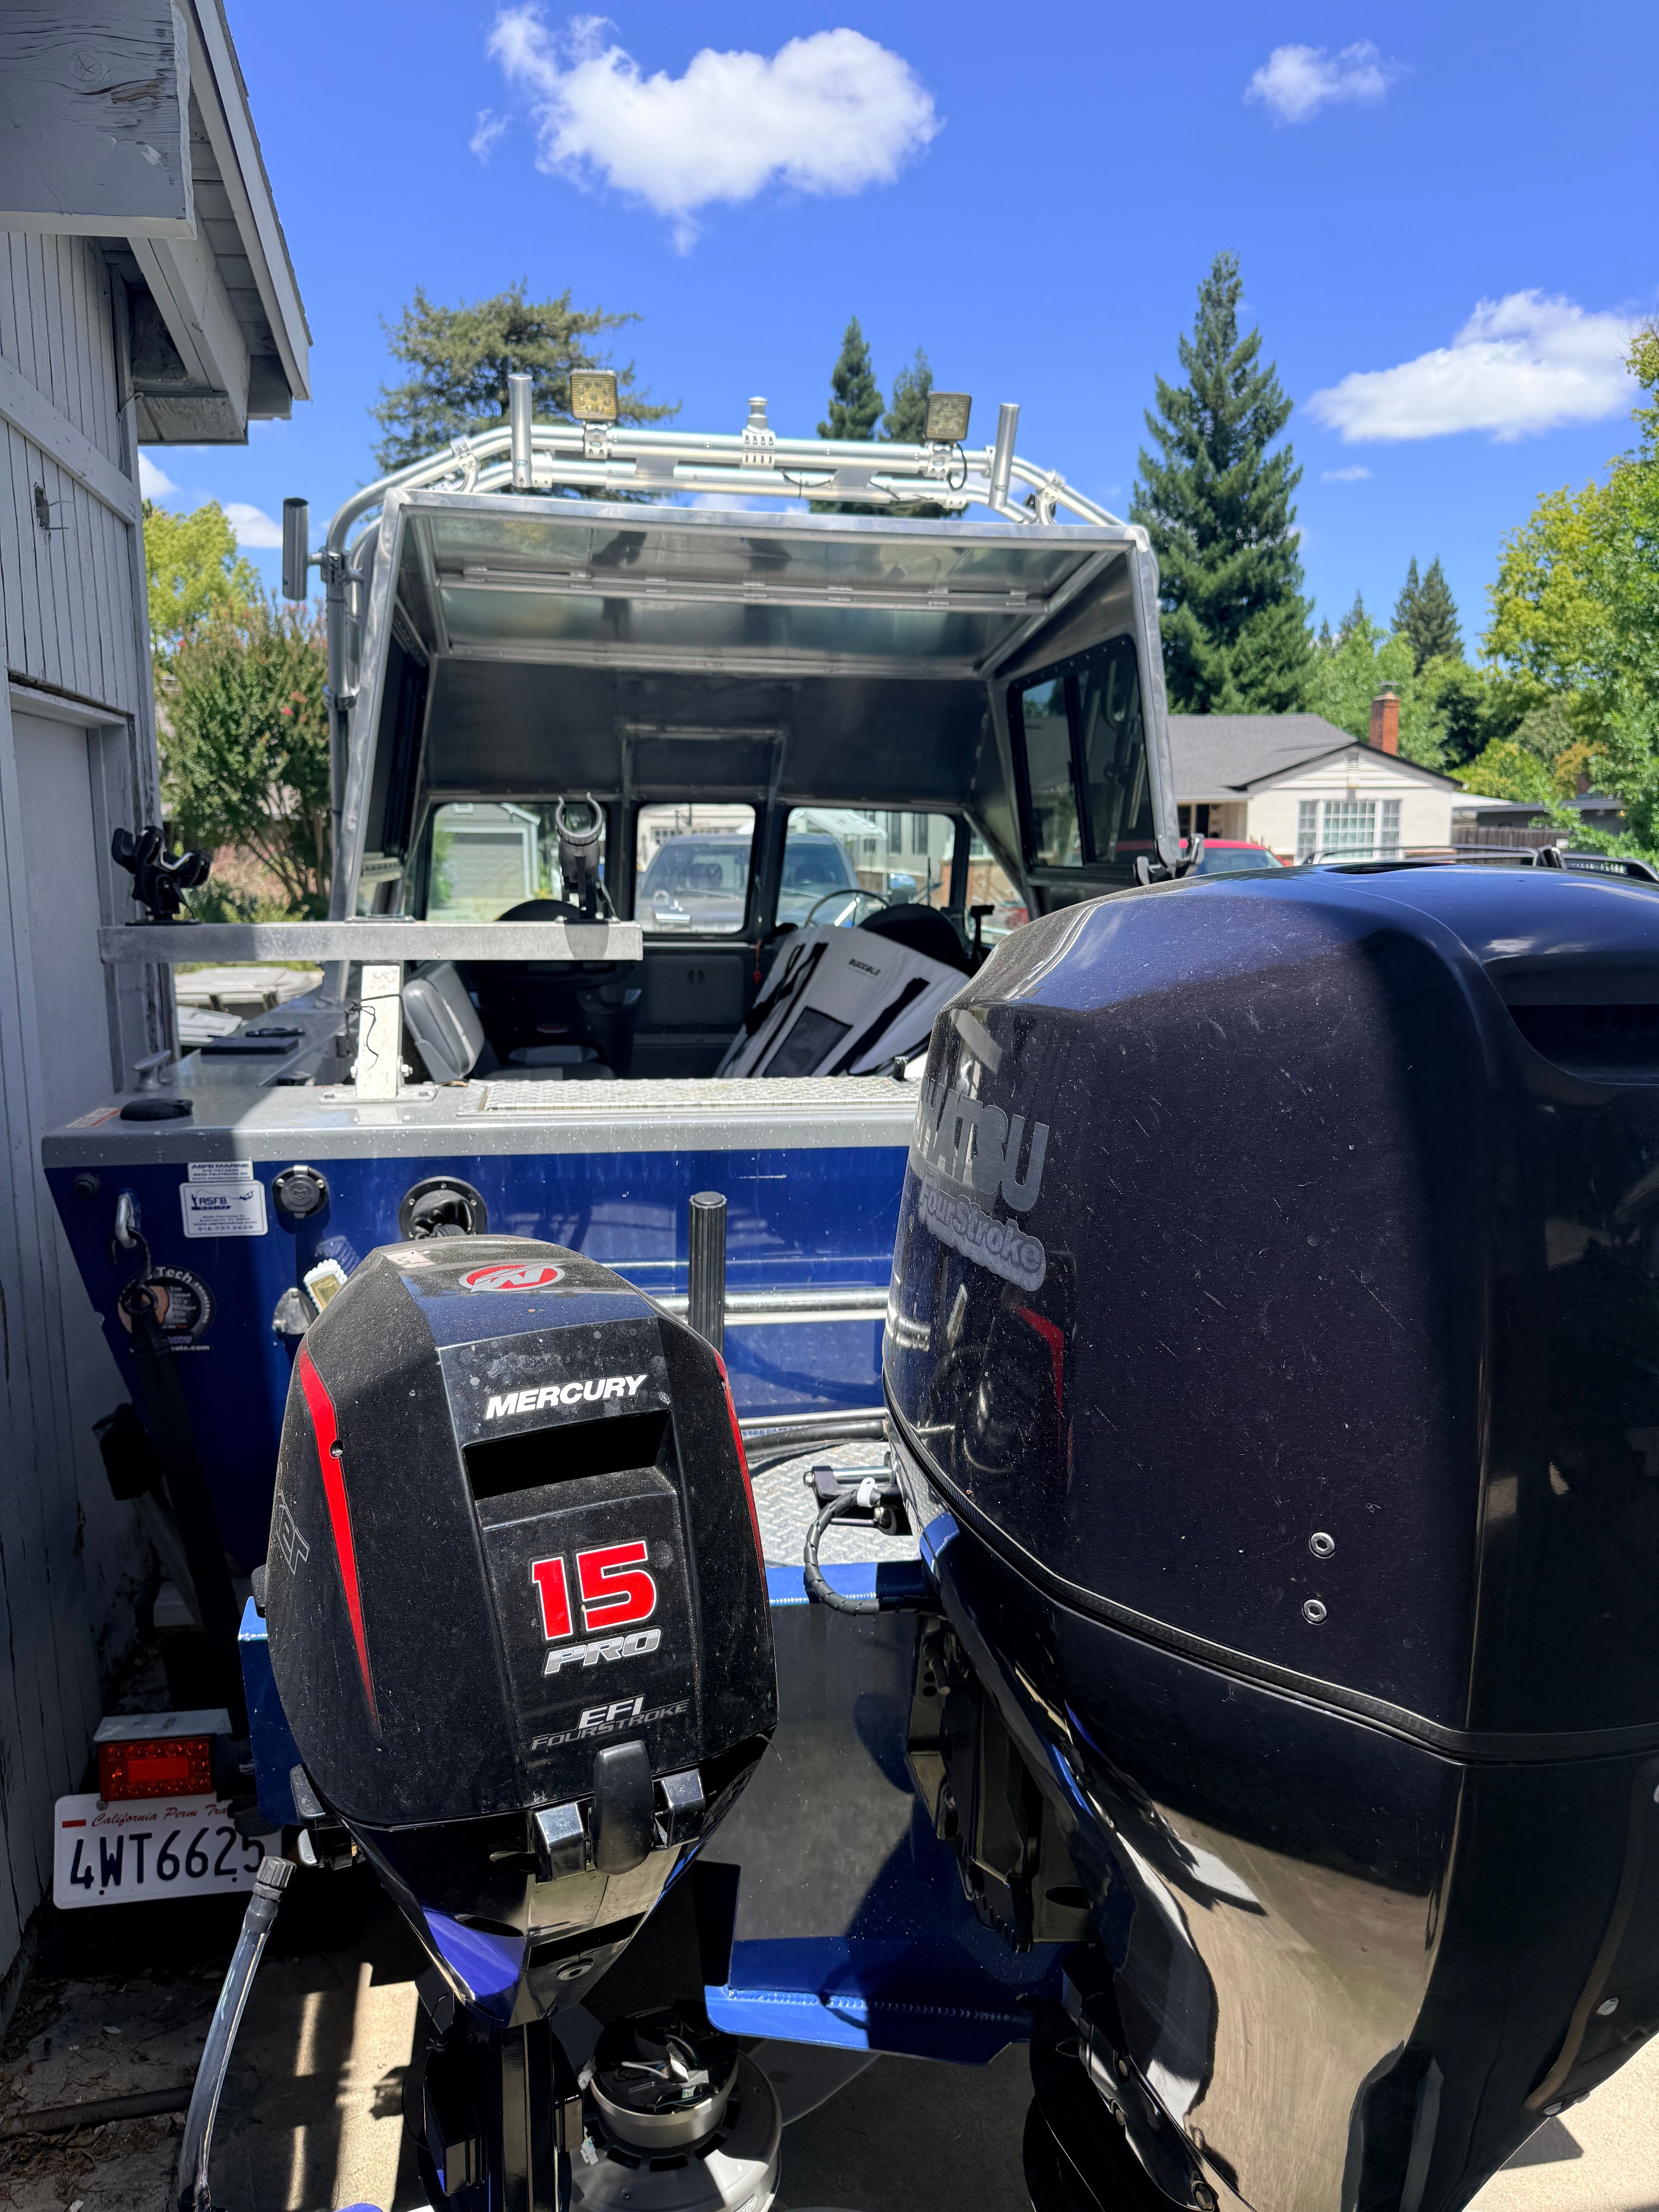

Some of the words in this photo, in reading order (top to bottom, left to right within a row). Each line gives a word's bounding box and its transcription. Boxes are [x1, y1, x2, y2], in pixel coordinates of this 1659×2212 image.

[155, 1266, 193, 1284] Tech
[485, 1374, 647, 1420] MERCURY
[532, 1540, 657, 1640] 15
[544, 1629, 661, 1676] PRO
[531, 1702, 689, 1750] FOURSTROKE
[578, 1697, 645, 1729] EFI
[91, 1811, 157, 1828] California
[163, 1807, 198, 1820] Perm
[70, 1826, 266, 1889] 4WT6625
